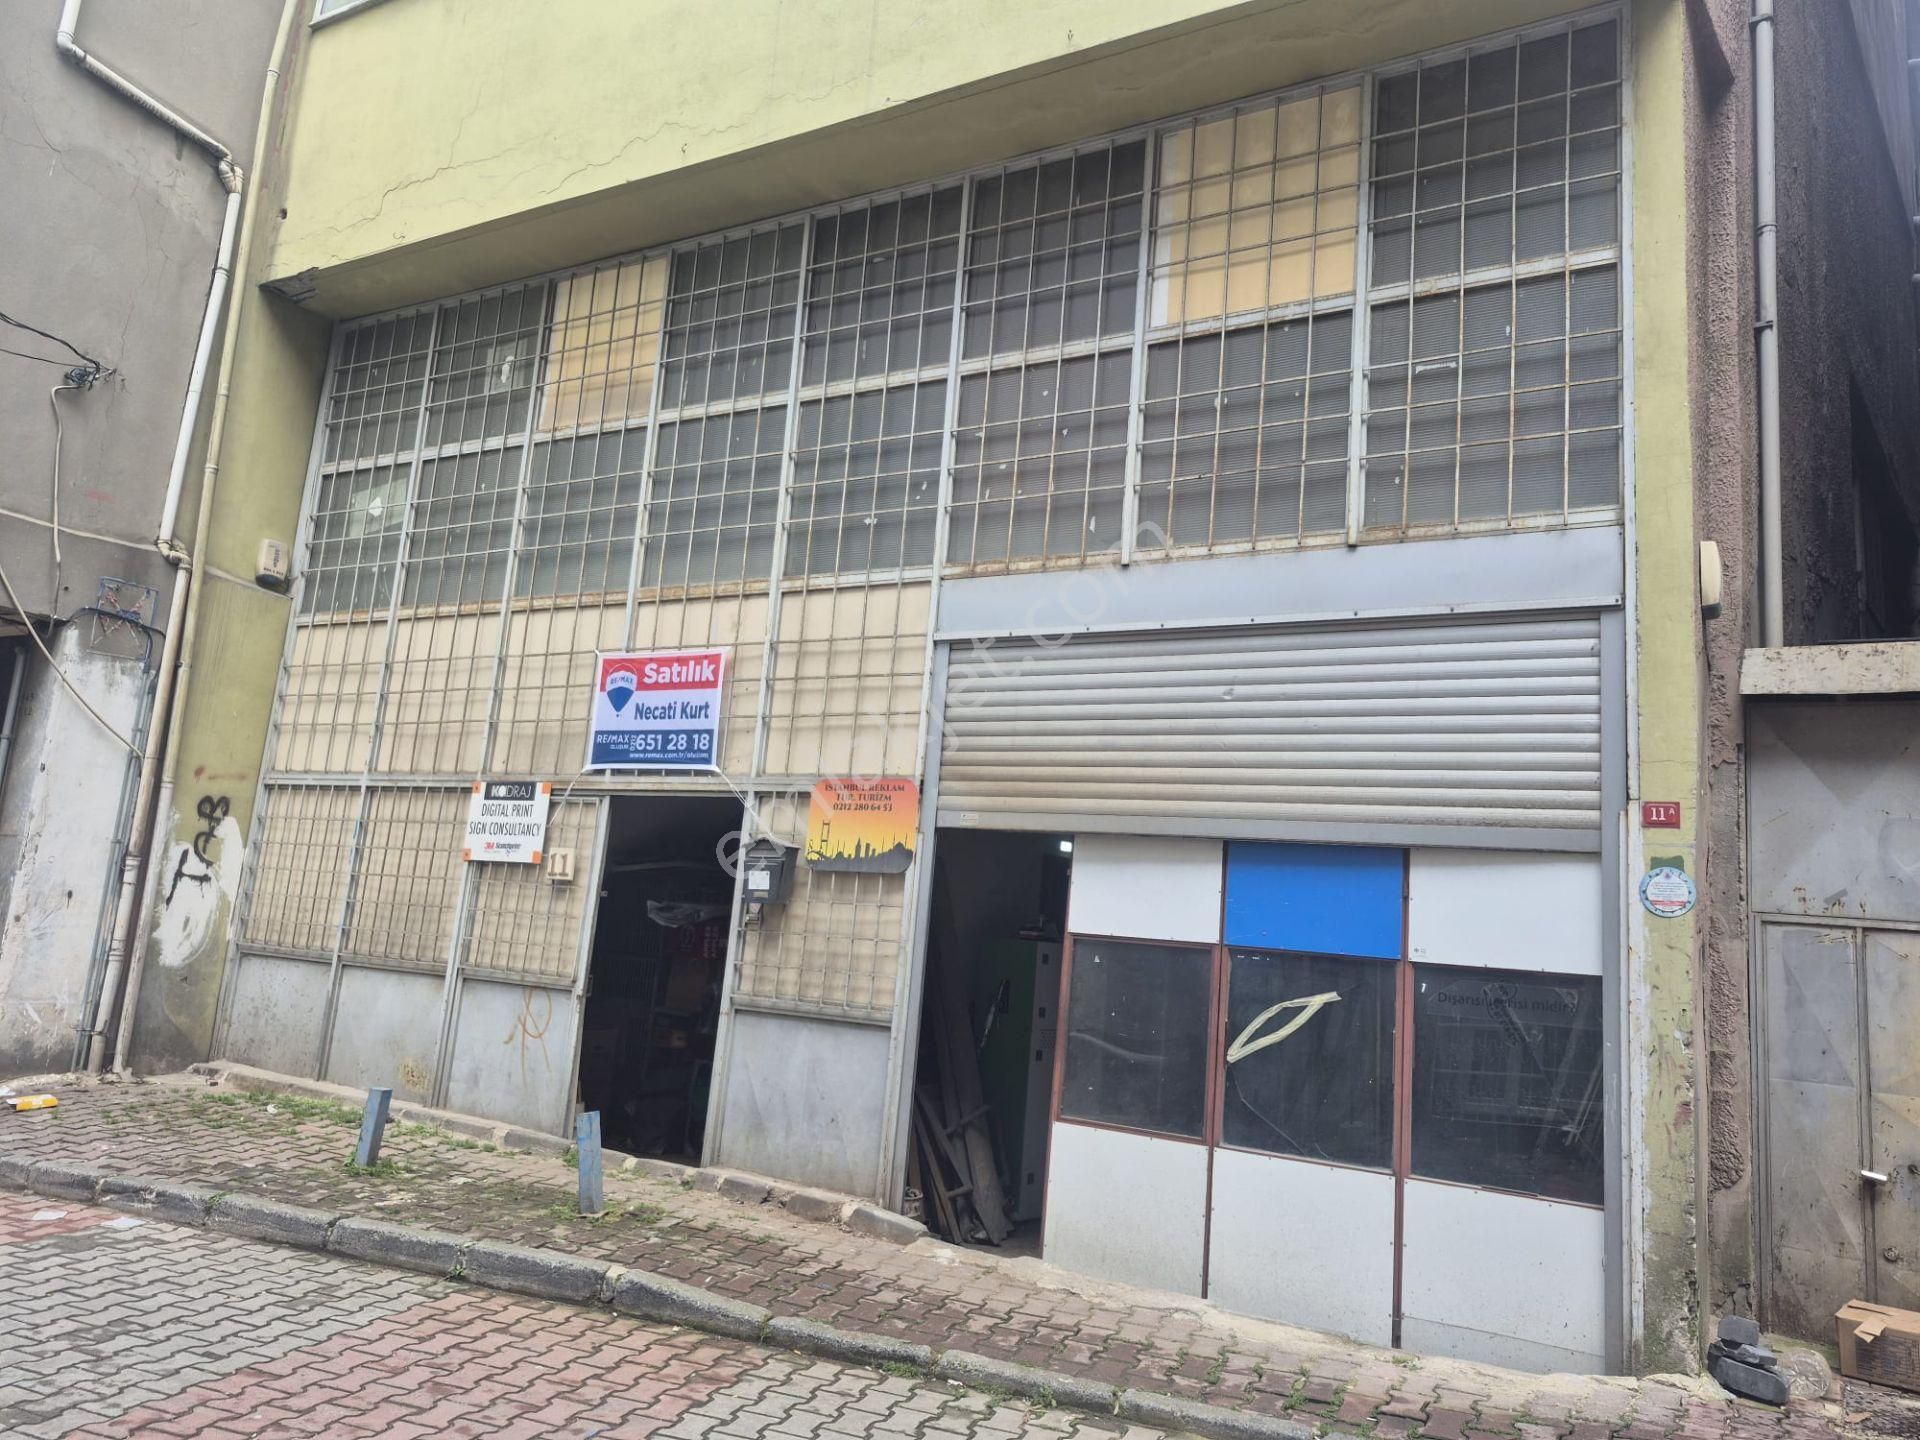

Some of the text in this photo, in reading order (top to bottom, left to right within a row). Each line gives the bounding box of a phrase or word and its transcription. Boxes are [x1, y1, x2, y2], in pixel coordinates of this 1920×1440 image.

[643, 660, 715, 684] Satılık
[634, 701, 710, 720] Necati Kurt
[596, 733, 630, 744] RE/MAX
[636, 733, 710, 751] 651 28 18
[869, 783, 905, 792] REKLAM
[481, 803, 535, 818] DIGITAL PRINT
[833, 802, 852, 811] 0212
[854, 802, 869, 811] 280
[1650, 807, 1667, 821] 11
[469, 821, 542, 837] SIGN CONSULTANCY
[547, 852, 569, 877] 11
